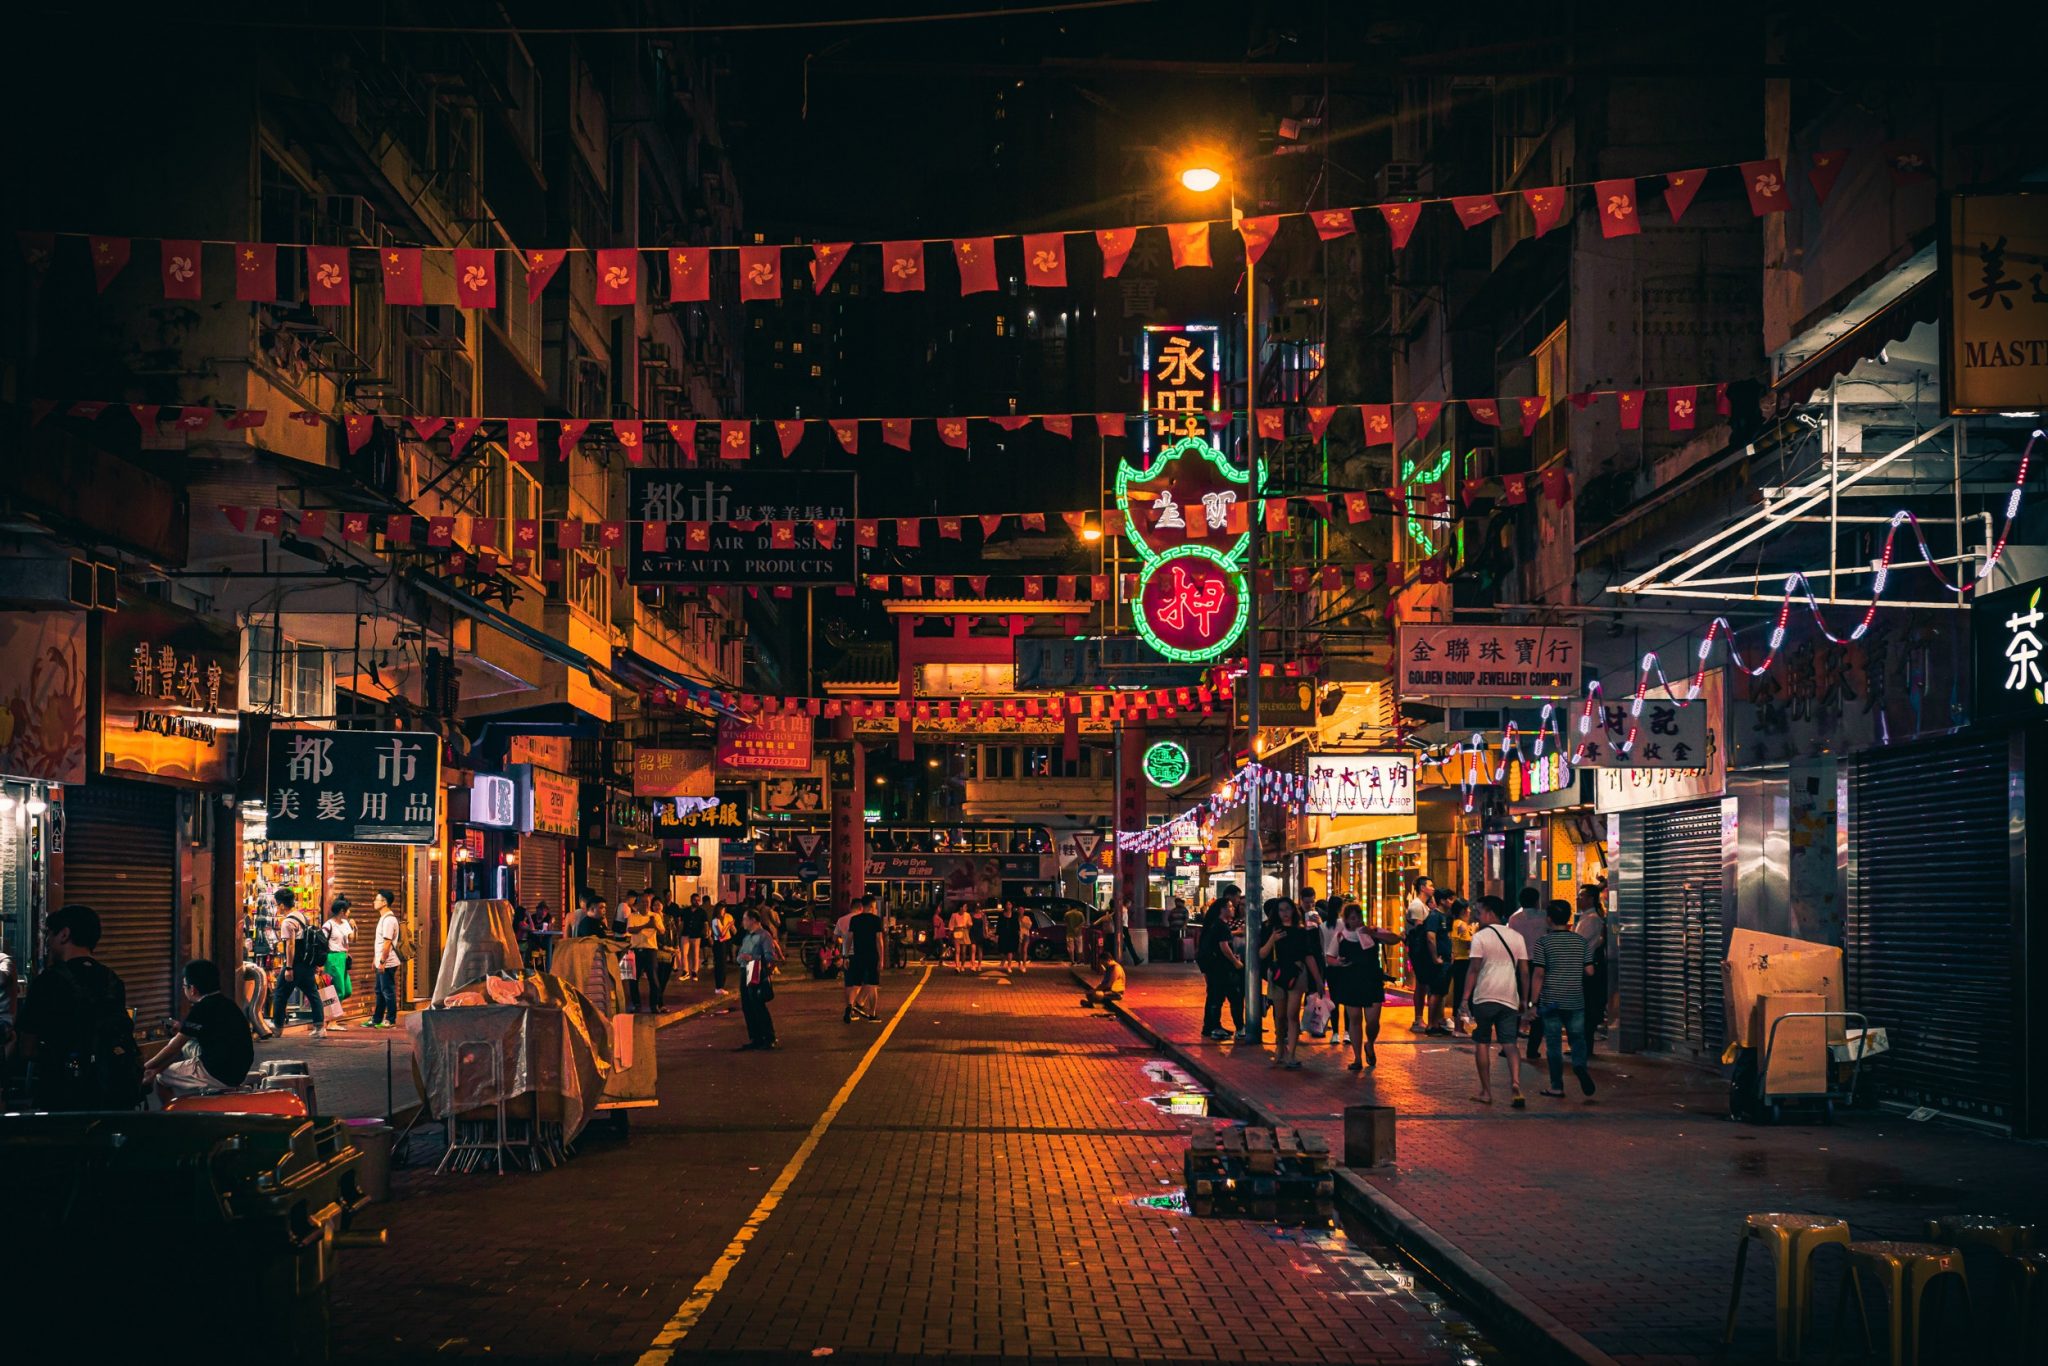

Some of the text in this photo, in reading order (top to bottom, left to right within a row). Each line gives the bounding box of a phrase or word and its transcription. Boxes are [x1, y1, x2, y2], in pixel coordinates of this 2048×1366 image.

[1965, 340, 2048, 369] MAST
[640, 480, 732, 525] 都市
[745, 559, 833, 573] PRODUCTS
[1157, 566, 1225, 637] 押
[1410, 637, 1573, 665] 金聯珠寶行
[2005, 607, 2044, 690] 茶
[1408, 671, 1573, 687] GOLDEN GROUP JEWELLERY COMPANY
[286, 735, 422, 787] 都市
[272, 788, 432, 822] 美髮用品
